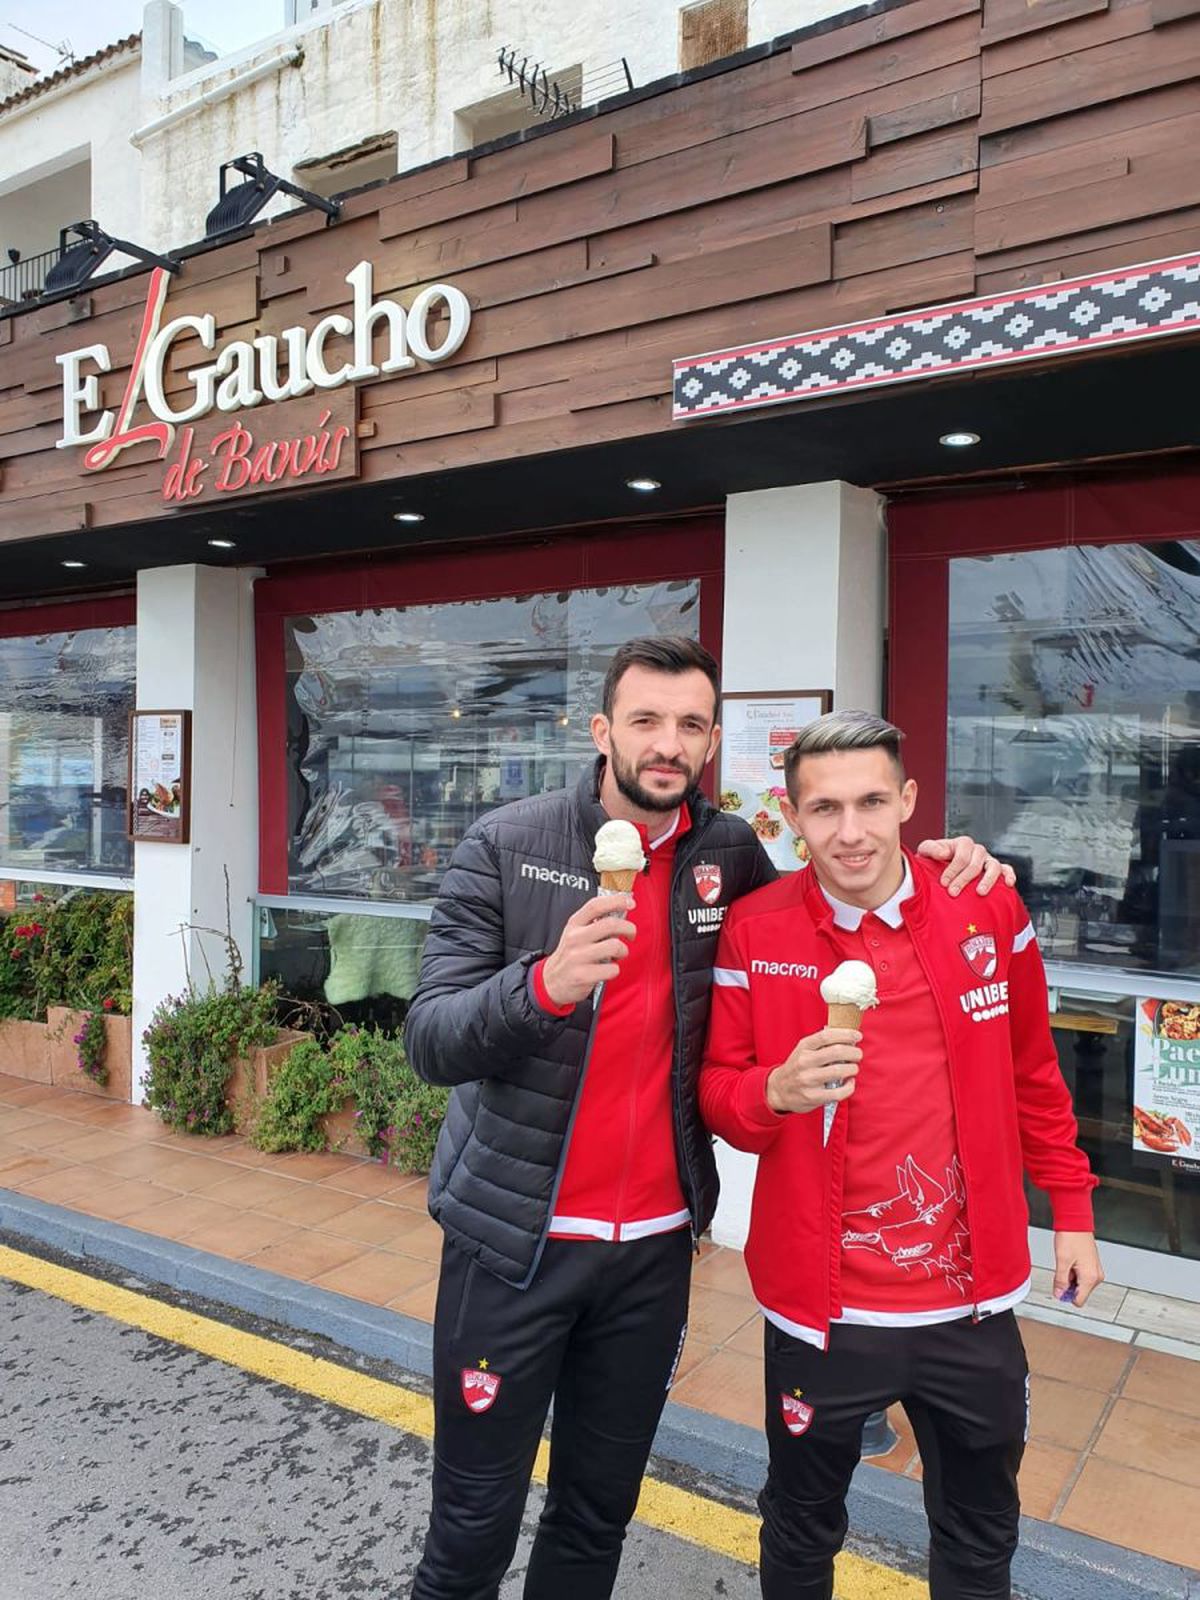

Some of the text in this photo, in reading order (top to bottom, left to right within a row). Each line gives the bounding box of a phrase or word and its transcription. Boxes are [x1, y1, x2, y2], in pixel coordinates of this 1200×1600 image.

[144, 260, 471, 423] Gaucho
[162, 409, 349, 500] de Banús
[520, 863, 590, 892] macron
[687, 905, 728, 925] UNIBE
[750, 959, 818, 980] macron
